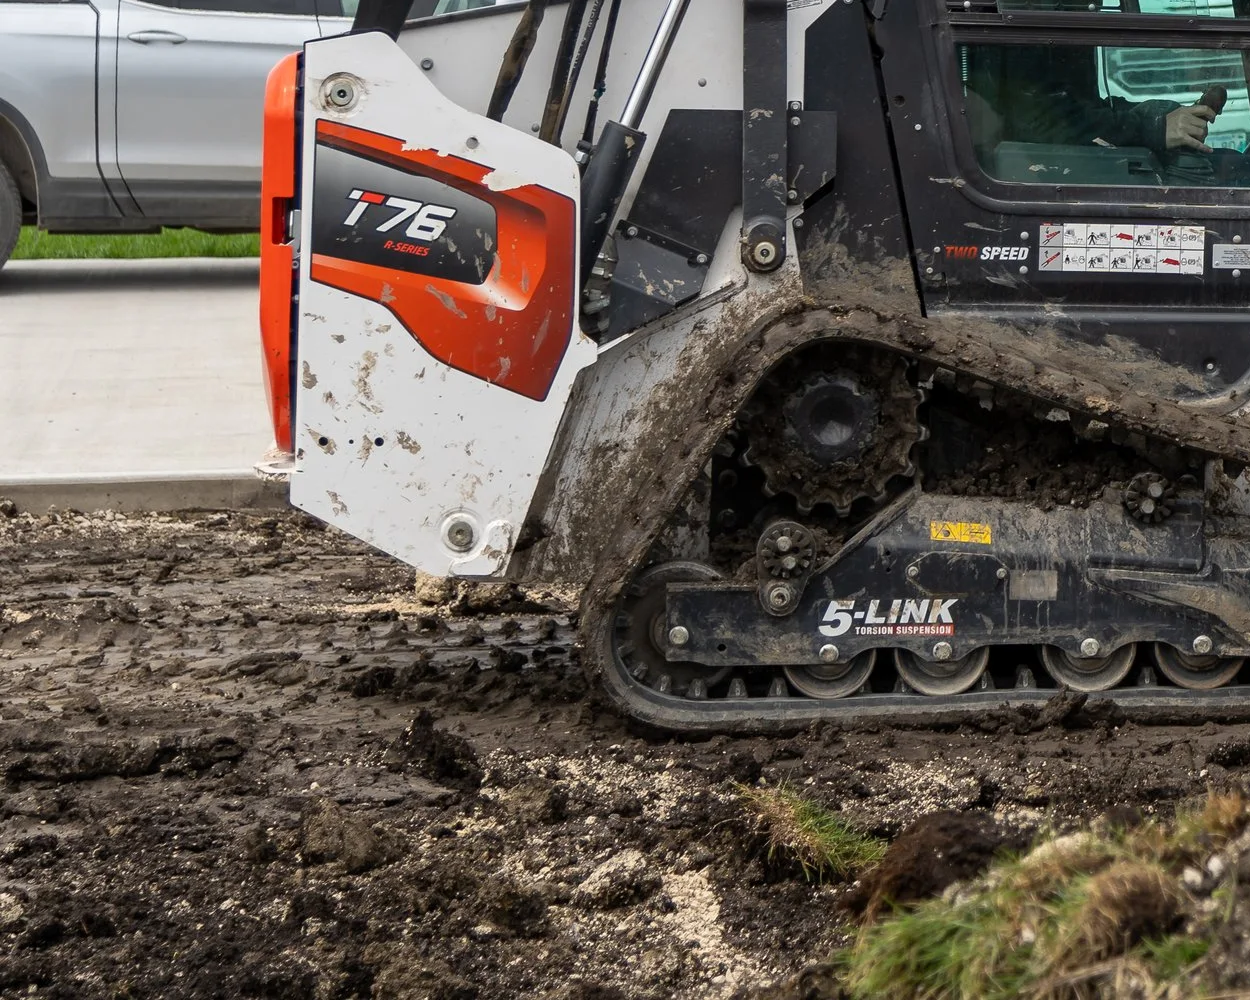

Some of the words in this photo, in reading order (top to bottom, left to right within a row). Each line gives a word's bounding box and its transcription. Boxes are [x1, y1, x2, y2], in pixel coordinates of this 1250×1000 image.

[344, 189, 457, 241] T76
[384, 241, 430, 256] R-SERIES
[944, 245, 978, 260] TWO
[980, 246, 1029, 261] SPEED
[818, 599, 959, 637] 5-LINK
[855, 625, 893, 635] TORSION
[896, 625, 952, 635] SUSPENSION
